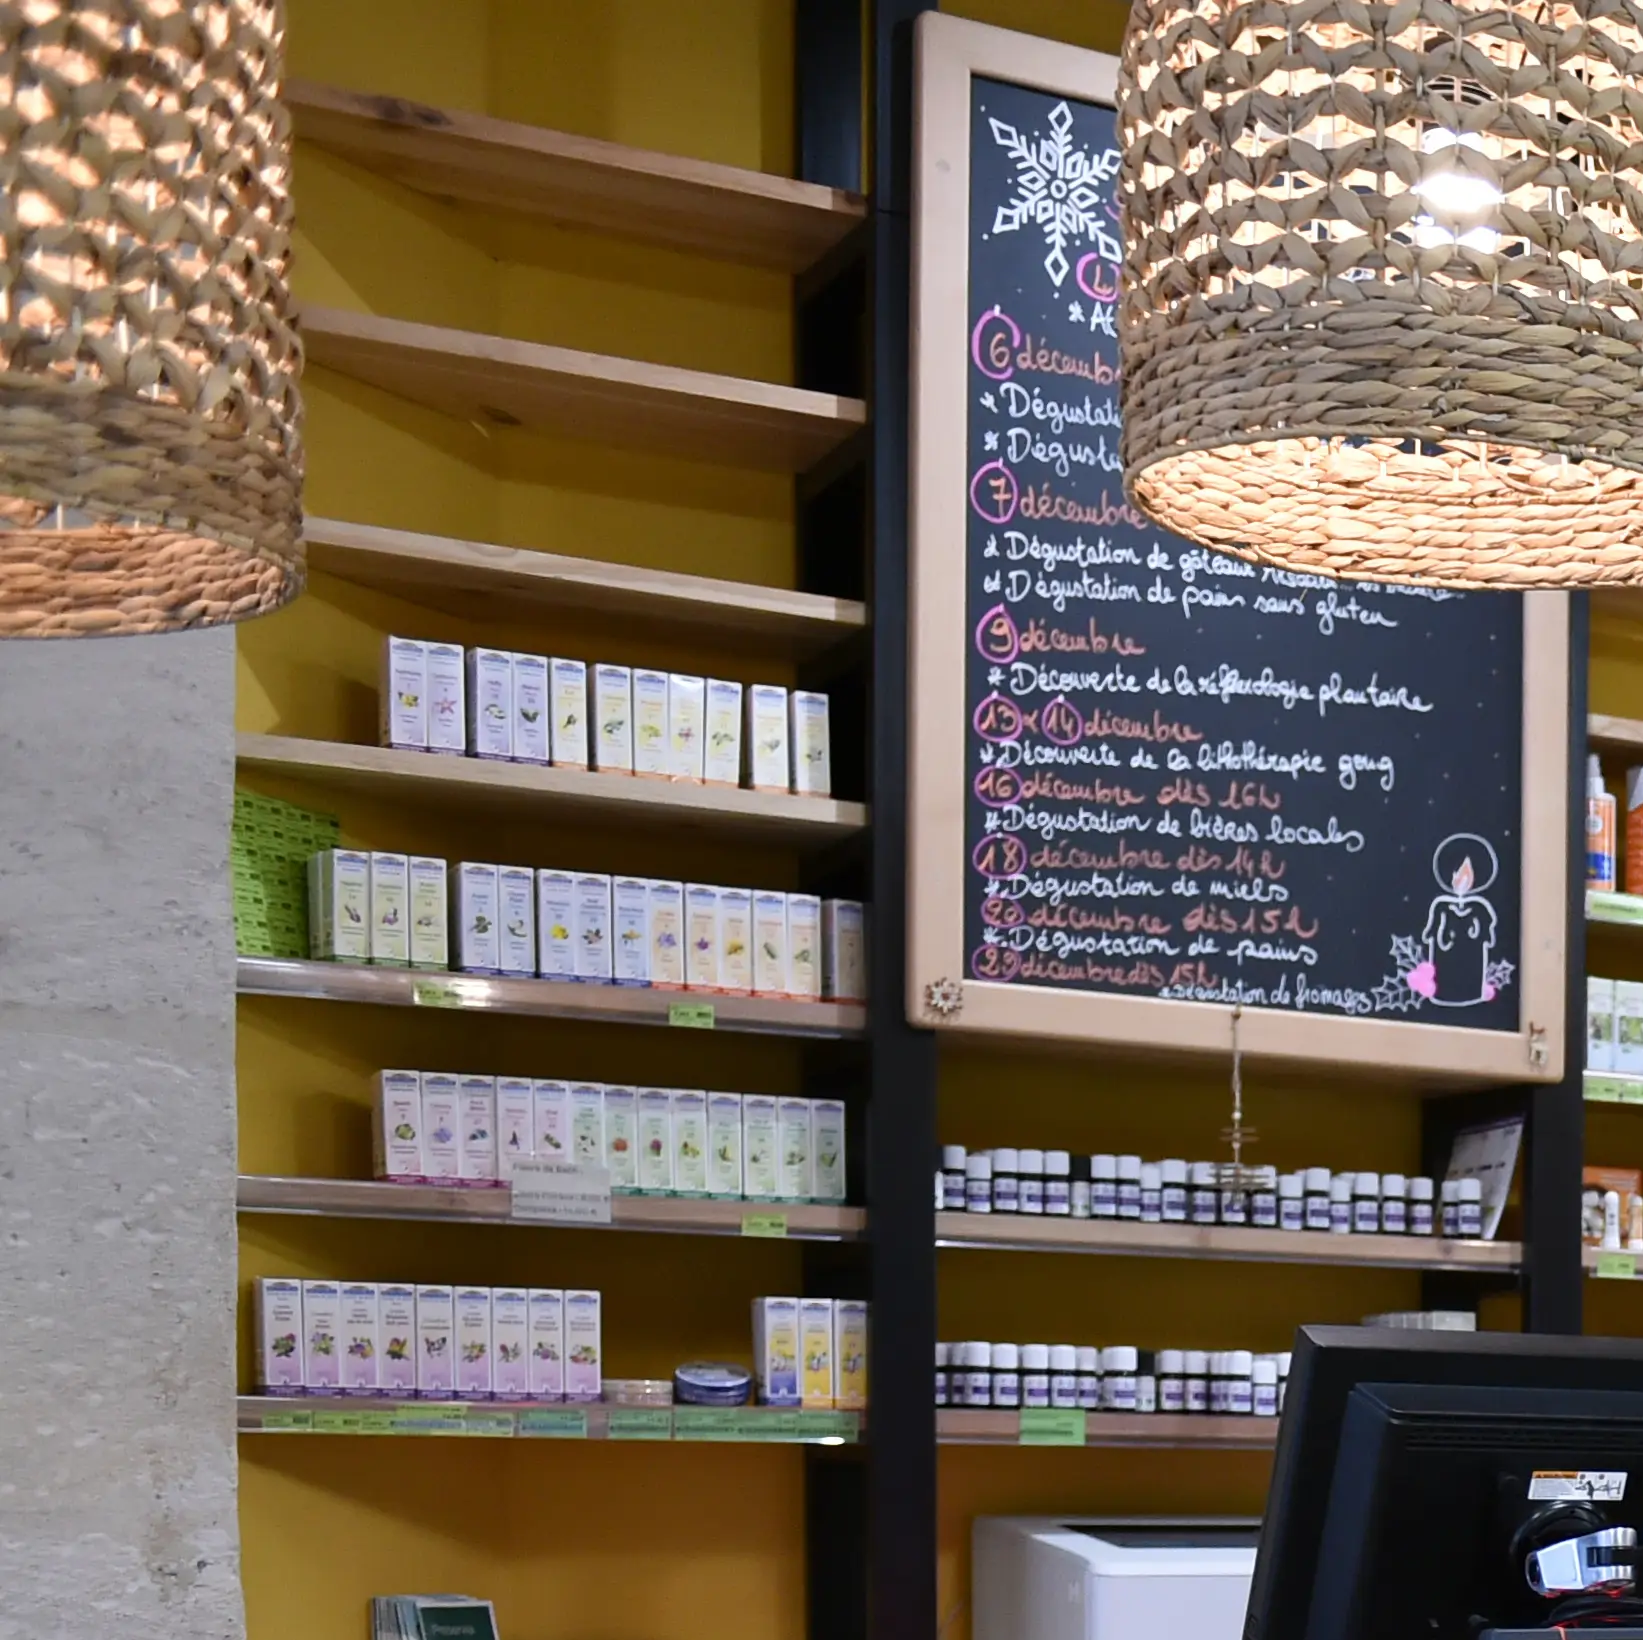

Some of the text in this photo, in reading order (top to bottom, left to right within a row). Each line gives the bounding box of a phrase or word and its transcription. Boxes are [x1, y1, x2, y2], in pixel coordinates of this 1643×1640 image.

[989, 333, 1122, 386] 6 décemb
[1000, 382, 1122, 434] Dégustati
[1007, 427, 1124, 477] Dégusta
[989, 478, 1148, 530] 7 décembre
[1003, 531, 1141, 571] Dégustation
[1147, 542, 1175, 571] de
[1005, 570, 1142, 612] Dégustation
[1147, 576, 1176, 604] de
[1316, 591, 1399, 635] gluten
[989, 616, 1147, 655] 9 décembre
[1010, 662, 1142, 696] Découverte
[1147, 666, 1173, 694] de
[1174, 665, 1198, 696] la
[1318, 671, 1435, 717] plantaire
[979, 703, 1018, 732] 13
[1046, 704, 1076, 737] 14
[1084, 709, 1204, 743] décembre
[1000, 740, 1121, 768] Découverte
[1130, 747, 1159, 771] de
[1167, 747, 1192, 771] la
[978, 772, 1282, 810] 16 décembre dès 16h
[1002, 804, 1153, 840] Dégustation
[1156, 810, 1183, 838] de
[1265, 815, 1366, 853] locales
[978, 844, 1019, 873] 18
[1030, 838, 1172, 870] décembre
[1176, 845, 1222, 873] dès
[1005, 873, 1290, 906] Dégustation de miels
[1027, 902, 1172, 935] décembre
[1182, 902, 1238, 935] dès
[1007, 924, 1319, 966] Dégustation de pains
[1020, 955, 1130, 983] décembre
[1270, 973, 1292, 1005] de
[1294, 973, 1373, 1014] fromages
